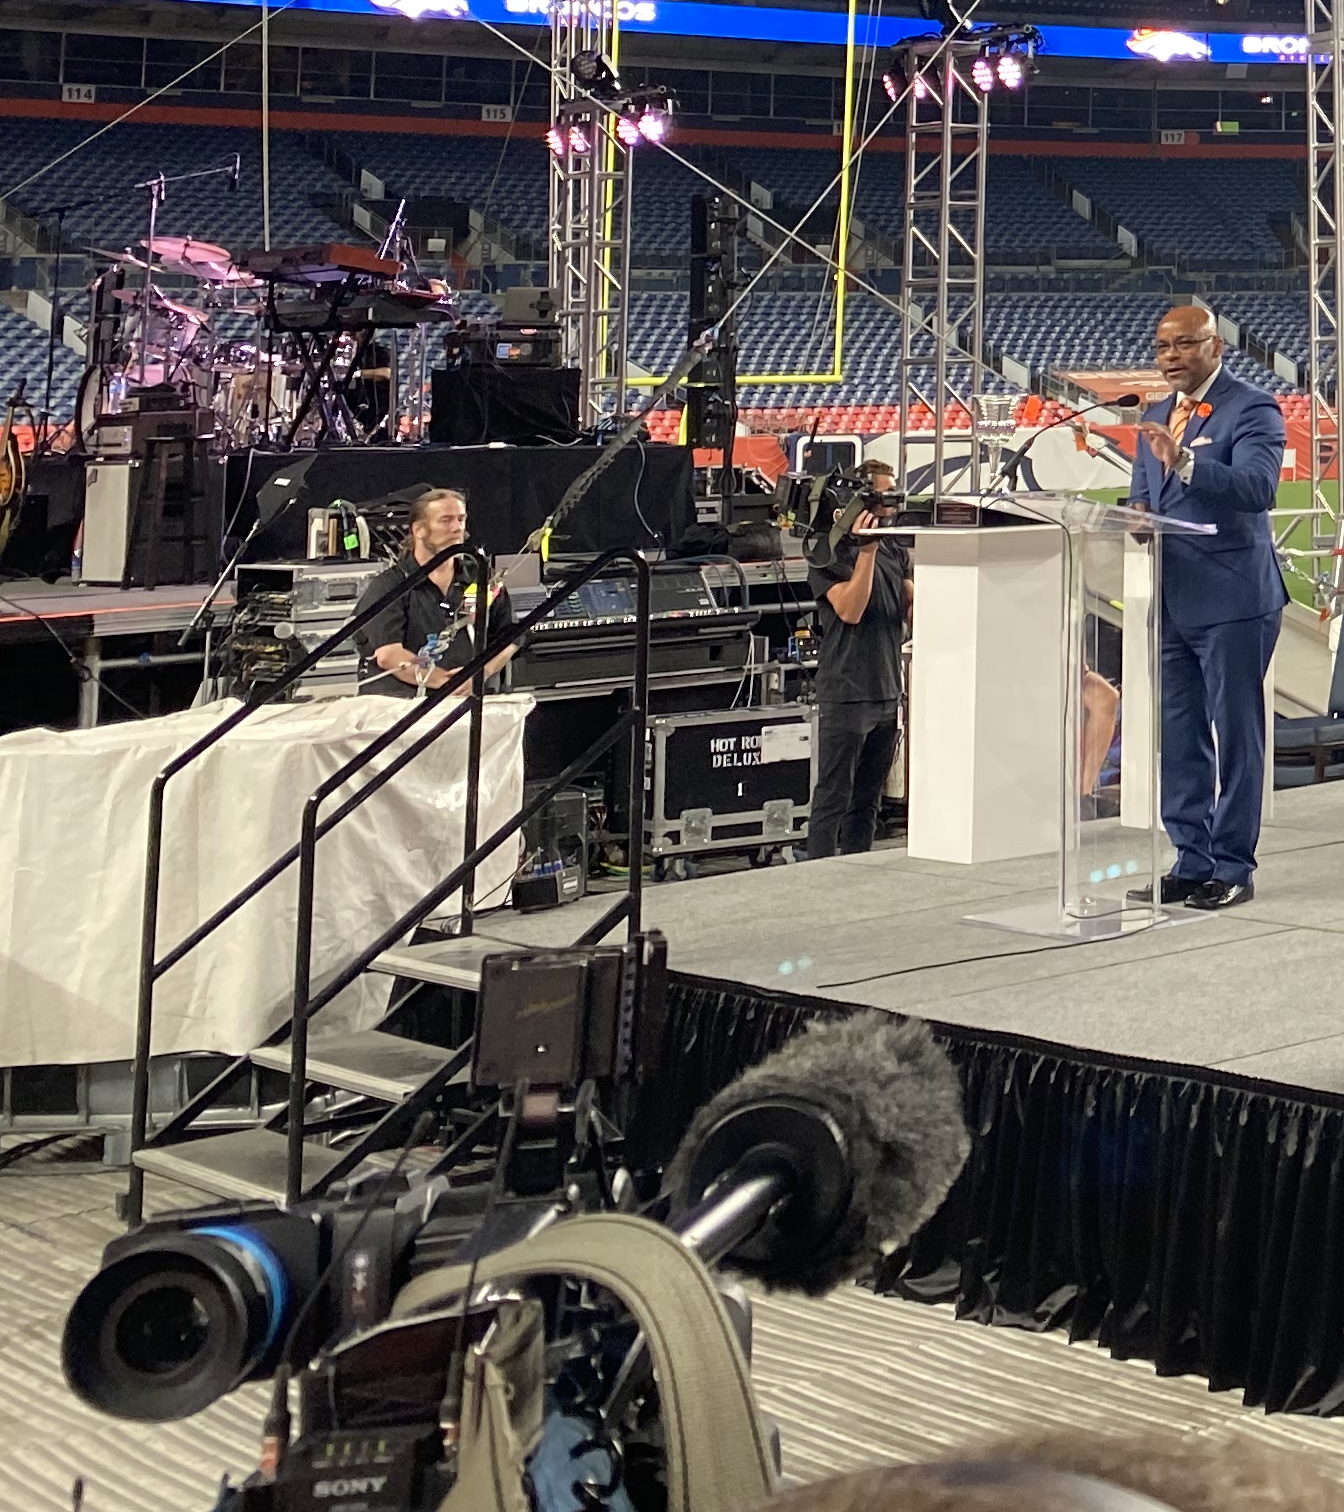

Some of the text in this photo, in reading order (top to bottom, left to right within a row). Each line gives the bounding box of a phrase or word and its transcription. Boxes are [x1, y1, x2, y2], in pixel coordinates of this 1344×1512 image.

[66, 87, 93, 100] 114
[484, 108, 508, 120] 115
[1163, 132, 1184, 143] 117
[710, 737, 737, 753] HOT
[712, 751, 762, 768] DELUX
[737, 782, 744, 797] 1
[312, 1475, 388, 1498] SONY
